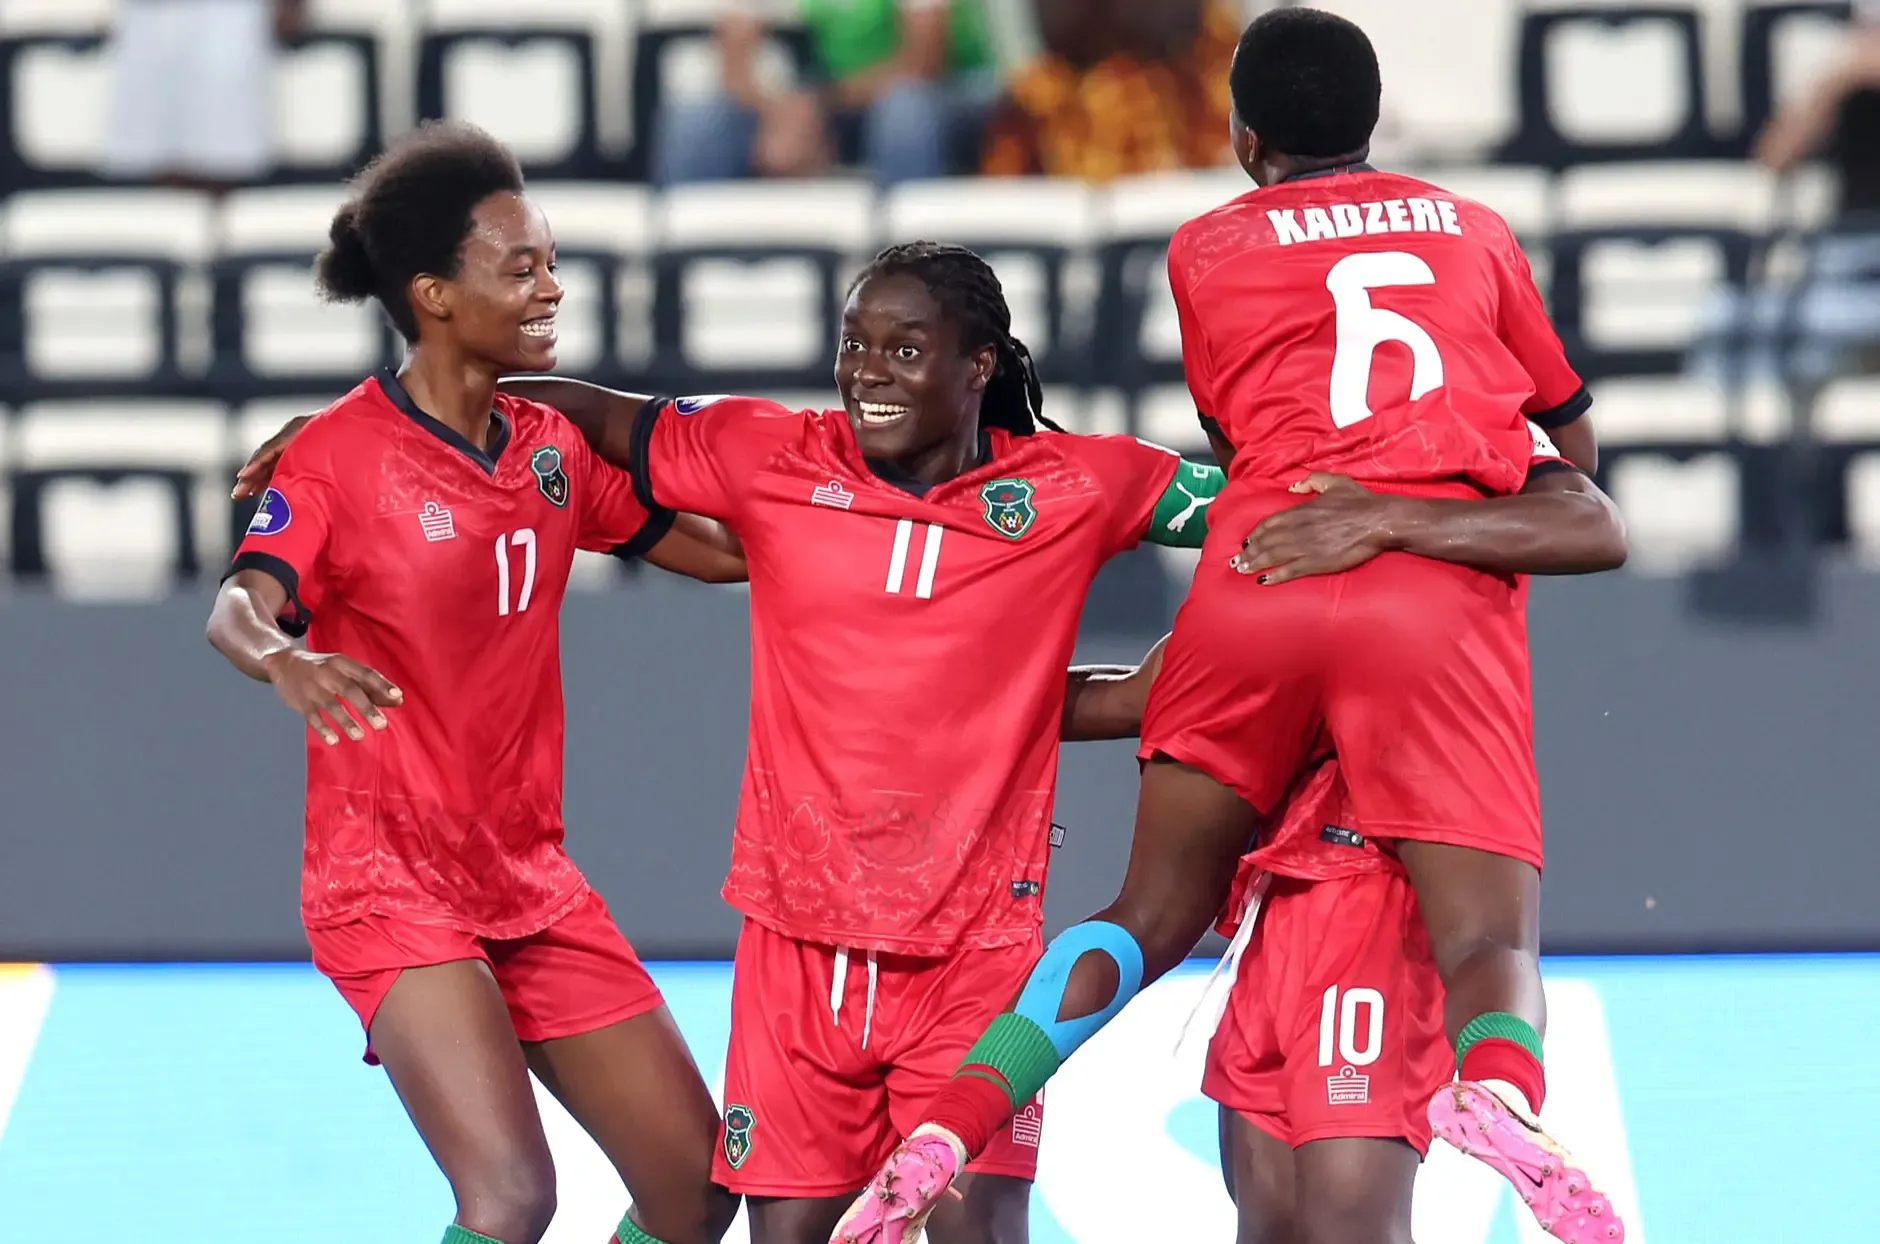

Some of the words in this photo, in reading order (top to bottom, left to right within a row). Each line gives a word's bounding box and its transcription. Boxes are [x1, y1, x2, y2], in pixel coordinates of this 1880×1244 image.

[1266, 197, 1463, 246] KADZERE
[1325, 251, 1444, 429] 6
[495, 528, 536, 616] 17
[885, 519, 944, 599] 11
[1318, 984, 1385, 1067] 10
[1332, 1092, 1365, 1101] Admiral
